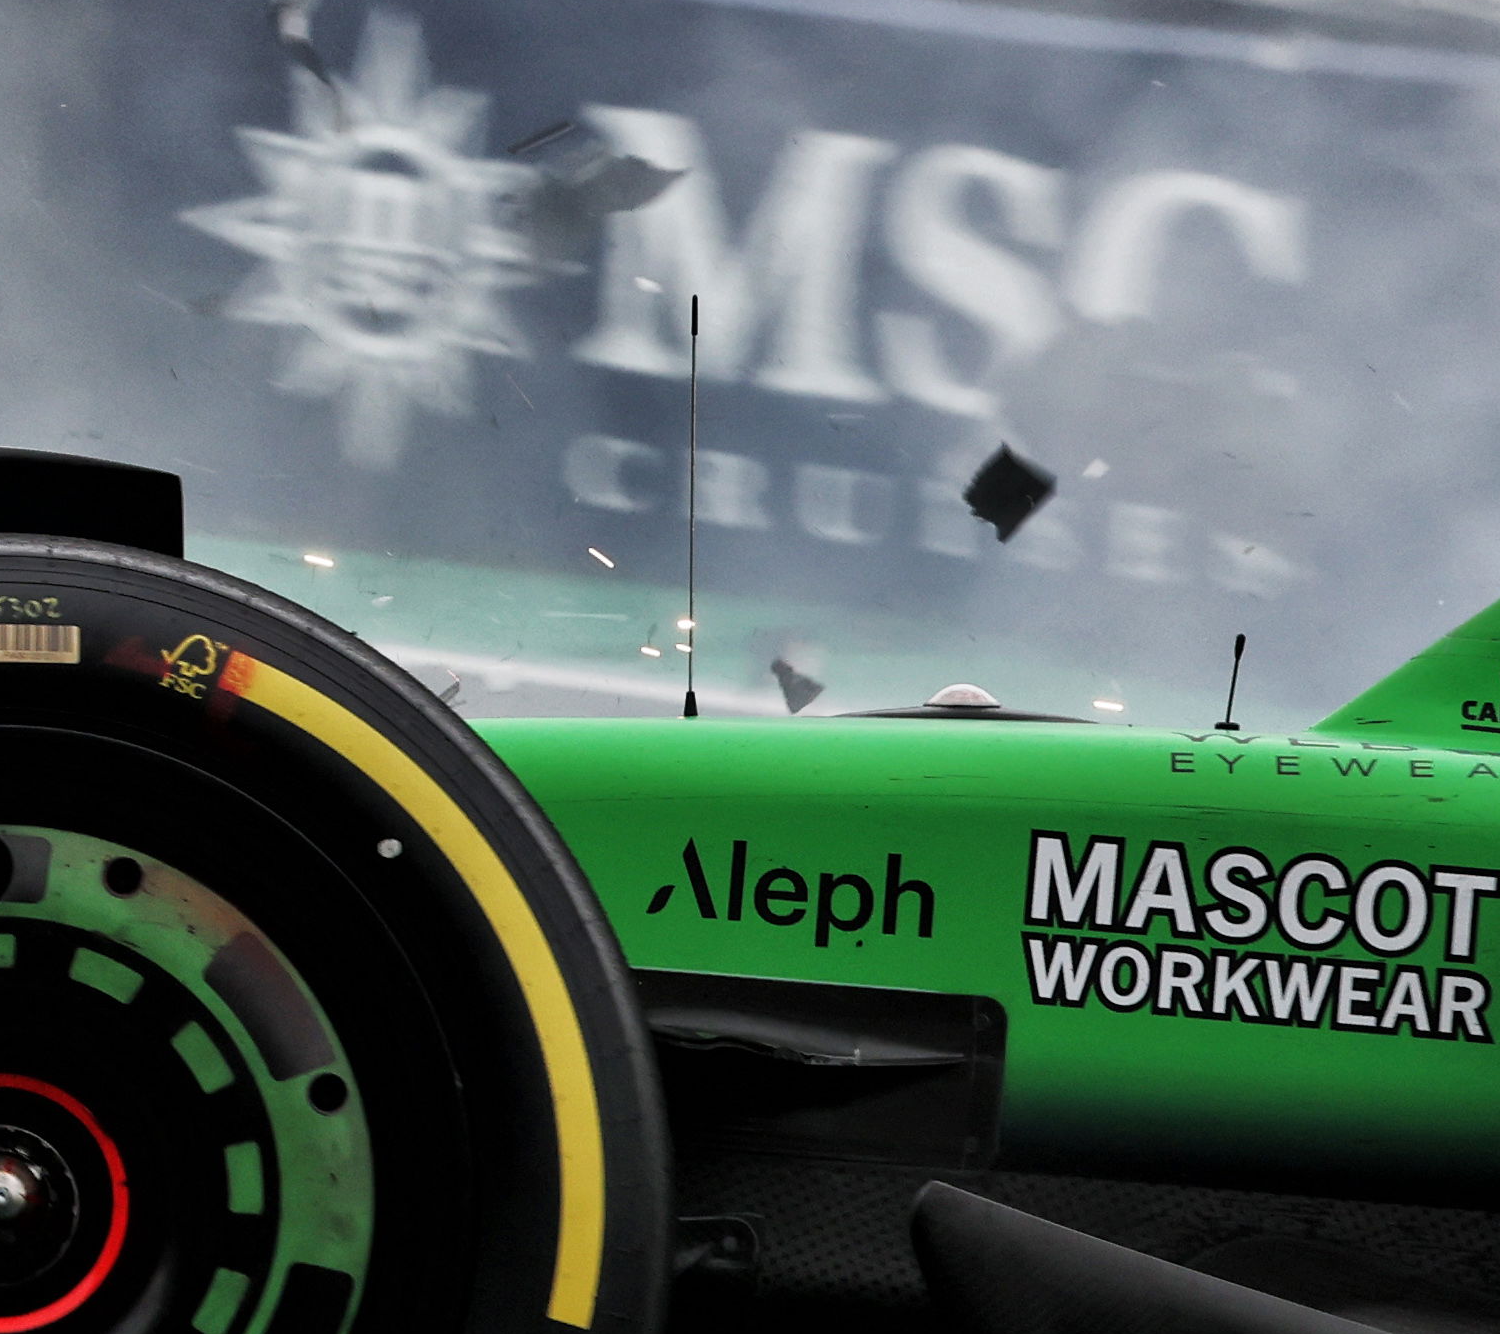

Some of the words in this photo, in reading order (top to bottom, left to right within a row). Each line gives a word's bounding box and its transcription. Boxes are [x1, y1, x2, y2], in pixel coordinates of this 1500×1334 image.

[158, 671, 207, 700] FSC
[645, 836, 936, 950] Aleph
[1022, 934, 1492, 1043] WORKWEAR
